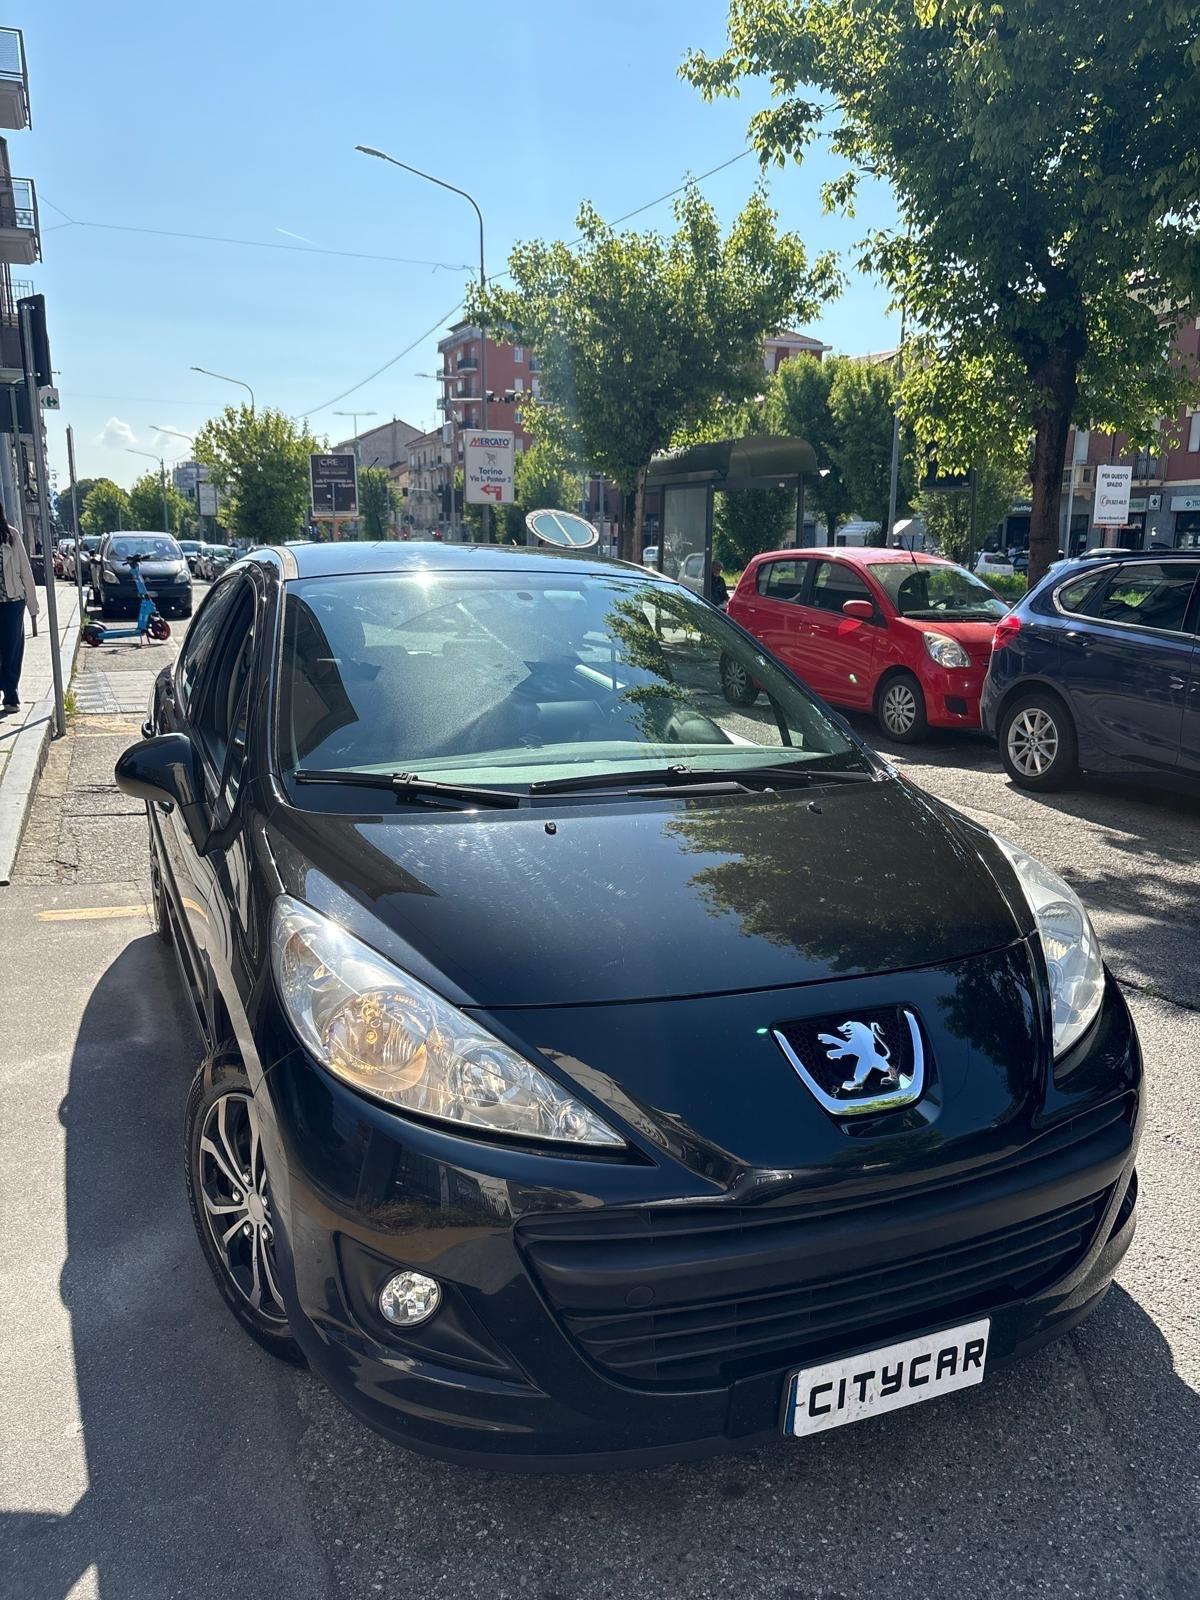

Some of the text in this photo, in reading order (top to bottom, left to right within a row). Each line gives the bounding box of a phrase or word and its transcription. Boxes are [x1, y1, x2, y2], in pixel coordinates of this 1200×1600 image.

[469, 437, 510, 447] MERCATO
[479, 466, 503, 475] Torino
[469, 474, 480, 482] Via
[808, 1338, 985, 1417] CITYCAR
